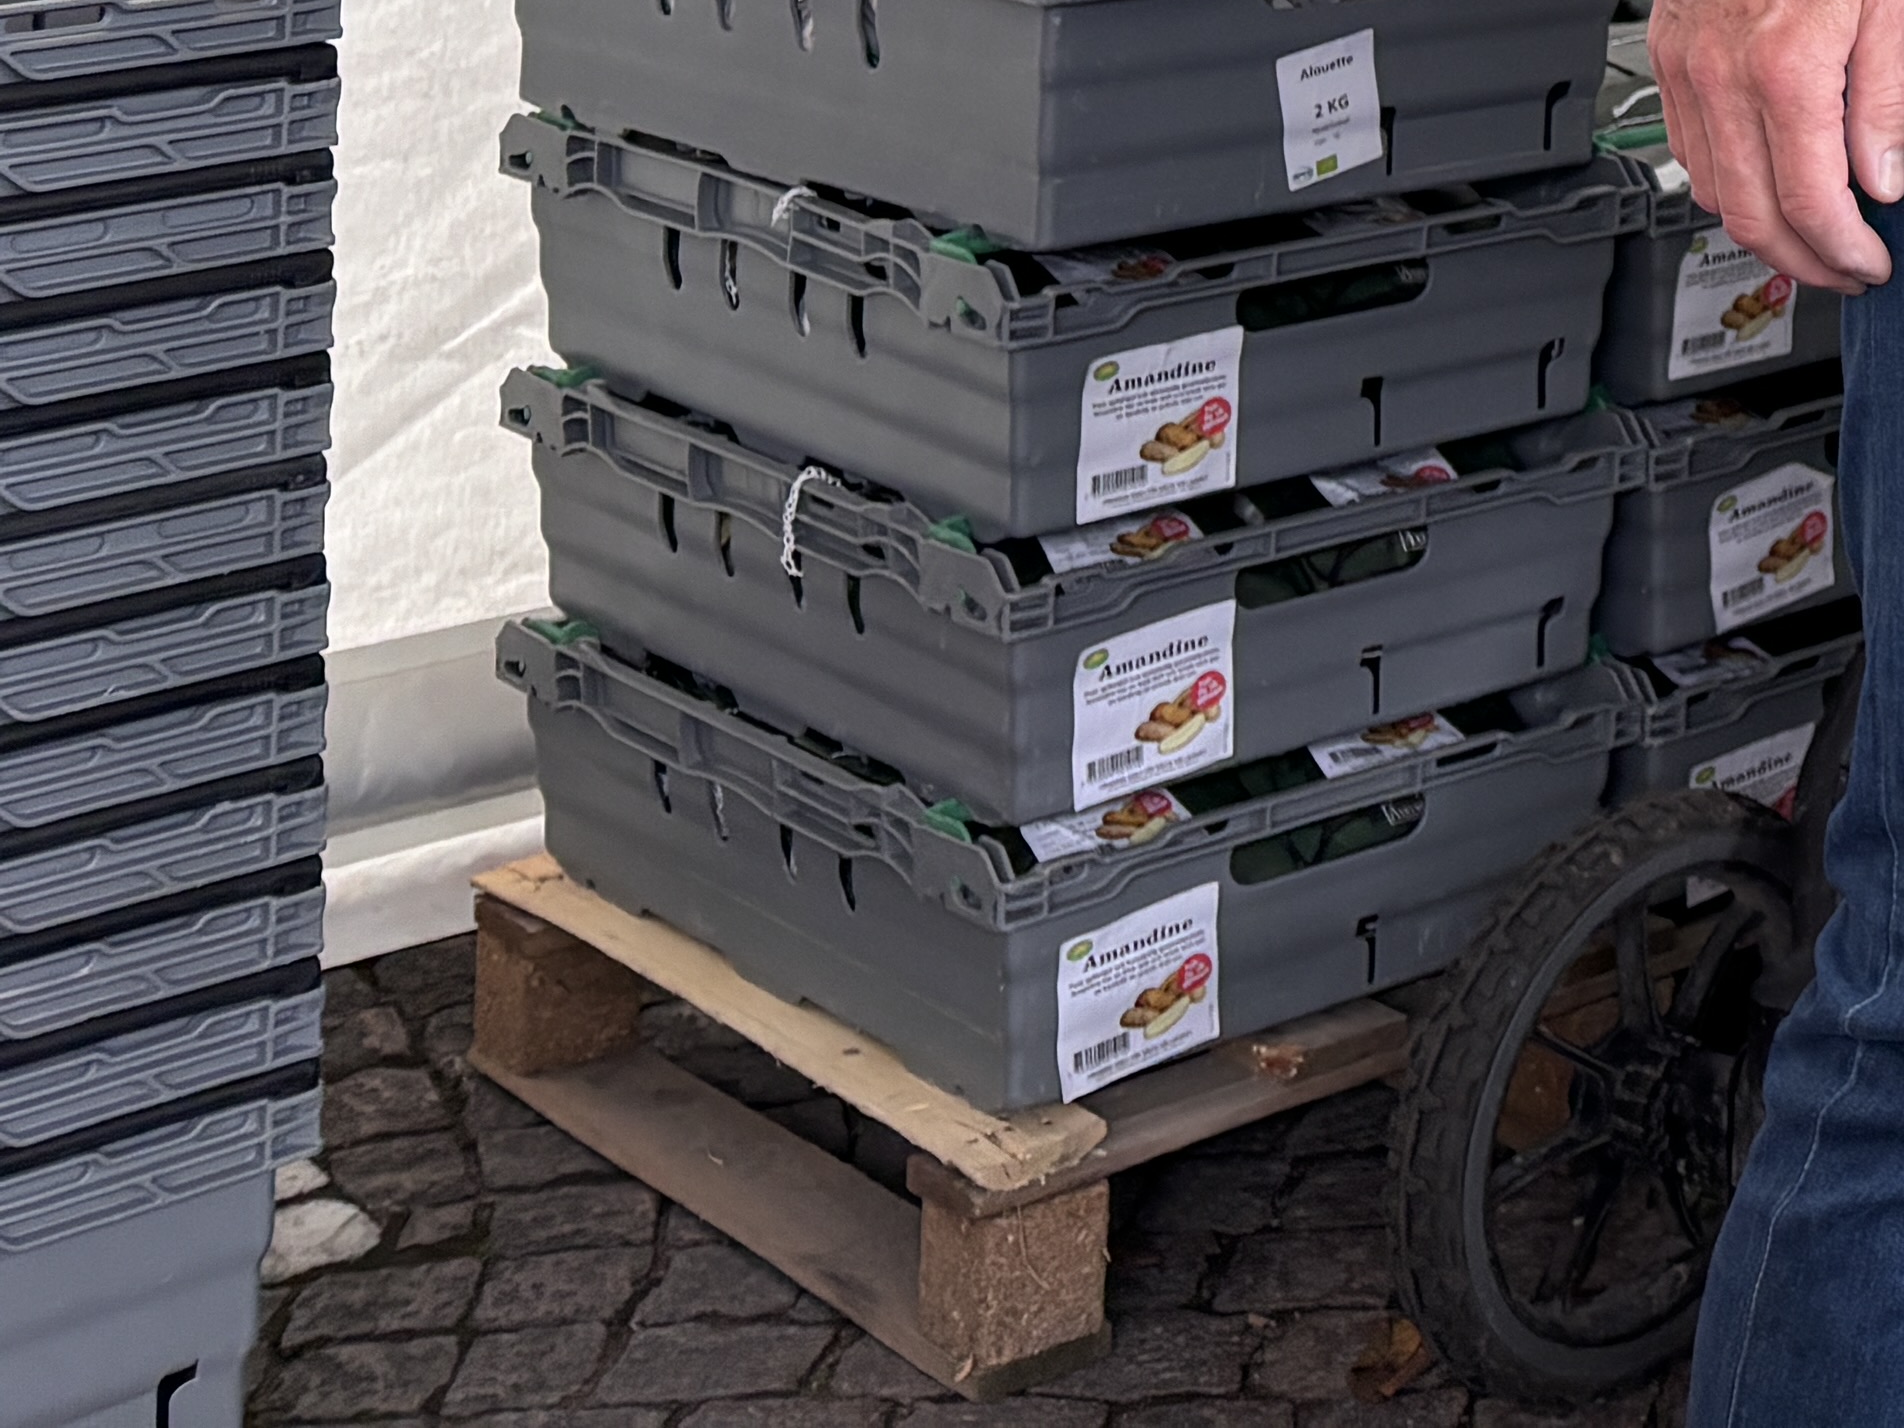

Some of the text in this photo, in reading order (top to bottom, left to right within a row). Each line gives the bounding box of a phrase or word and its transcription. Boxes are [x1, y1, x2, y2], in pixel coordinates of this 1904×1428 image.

[1300, 55, 1354, 82] Alouette
[1314, 94, 1350, 119] 2 KG
[1699, 248, 1752, 268] Aman
[1108, 359, 1217, 395] Amandine
[1729, 480, 1814, 524] Amandine
[1098, 635, 1209, 682] Amandine
[1082, 918, 1194, 973] Amandine
